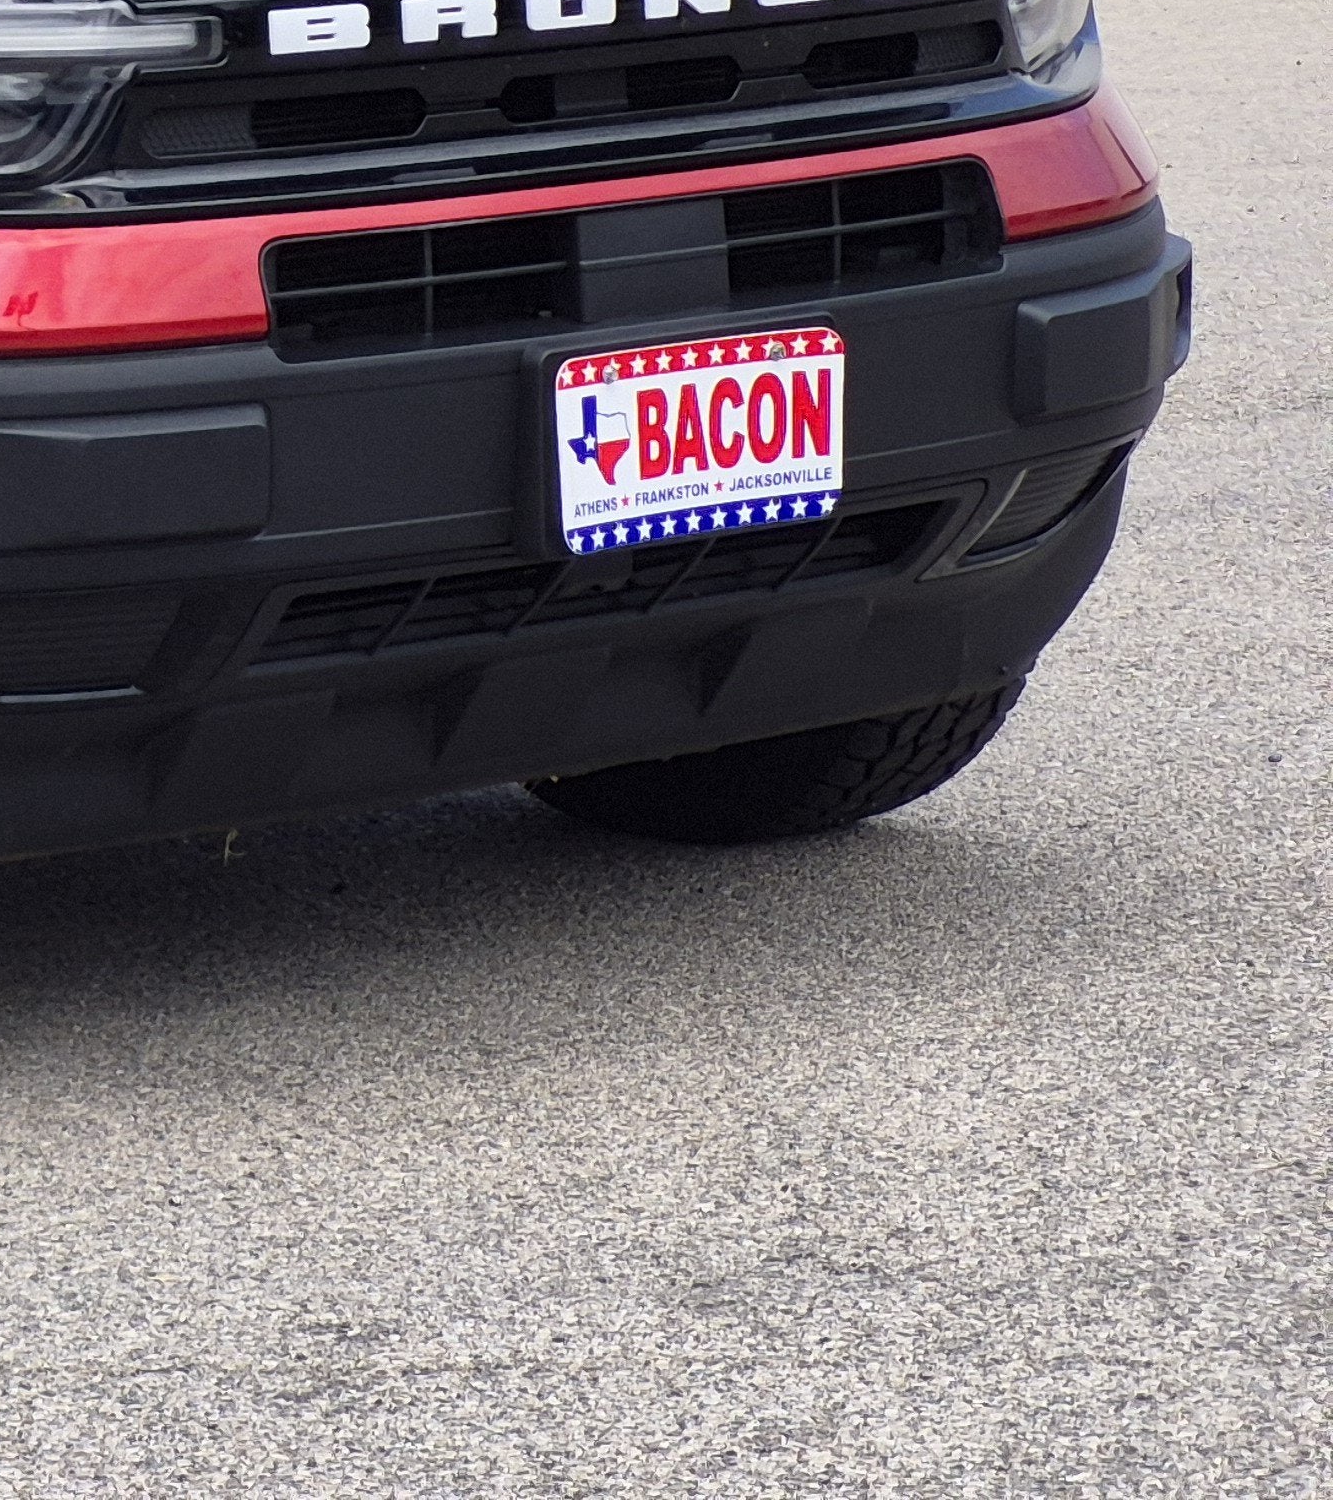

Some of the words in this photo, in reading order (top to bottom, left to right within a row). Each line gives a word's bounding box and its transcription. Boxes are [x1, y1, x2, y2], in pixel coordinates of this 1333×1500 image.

[636, 368, 833, 481] BACON
[573, 496, 619, 518] ATHENS
[634, 482, 709, 507] FRANKSTON
[729, 466, 833, 492] JACKSONVILLE
